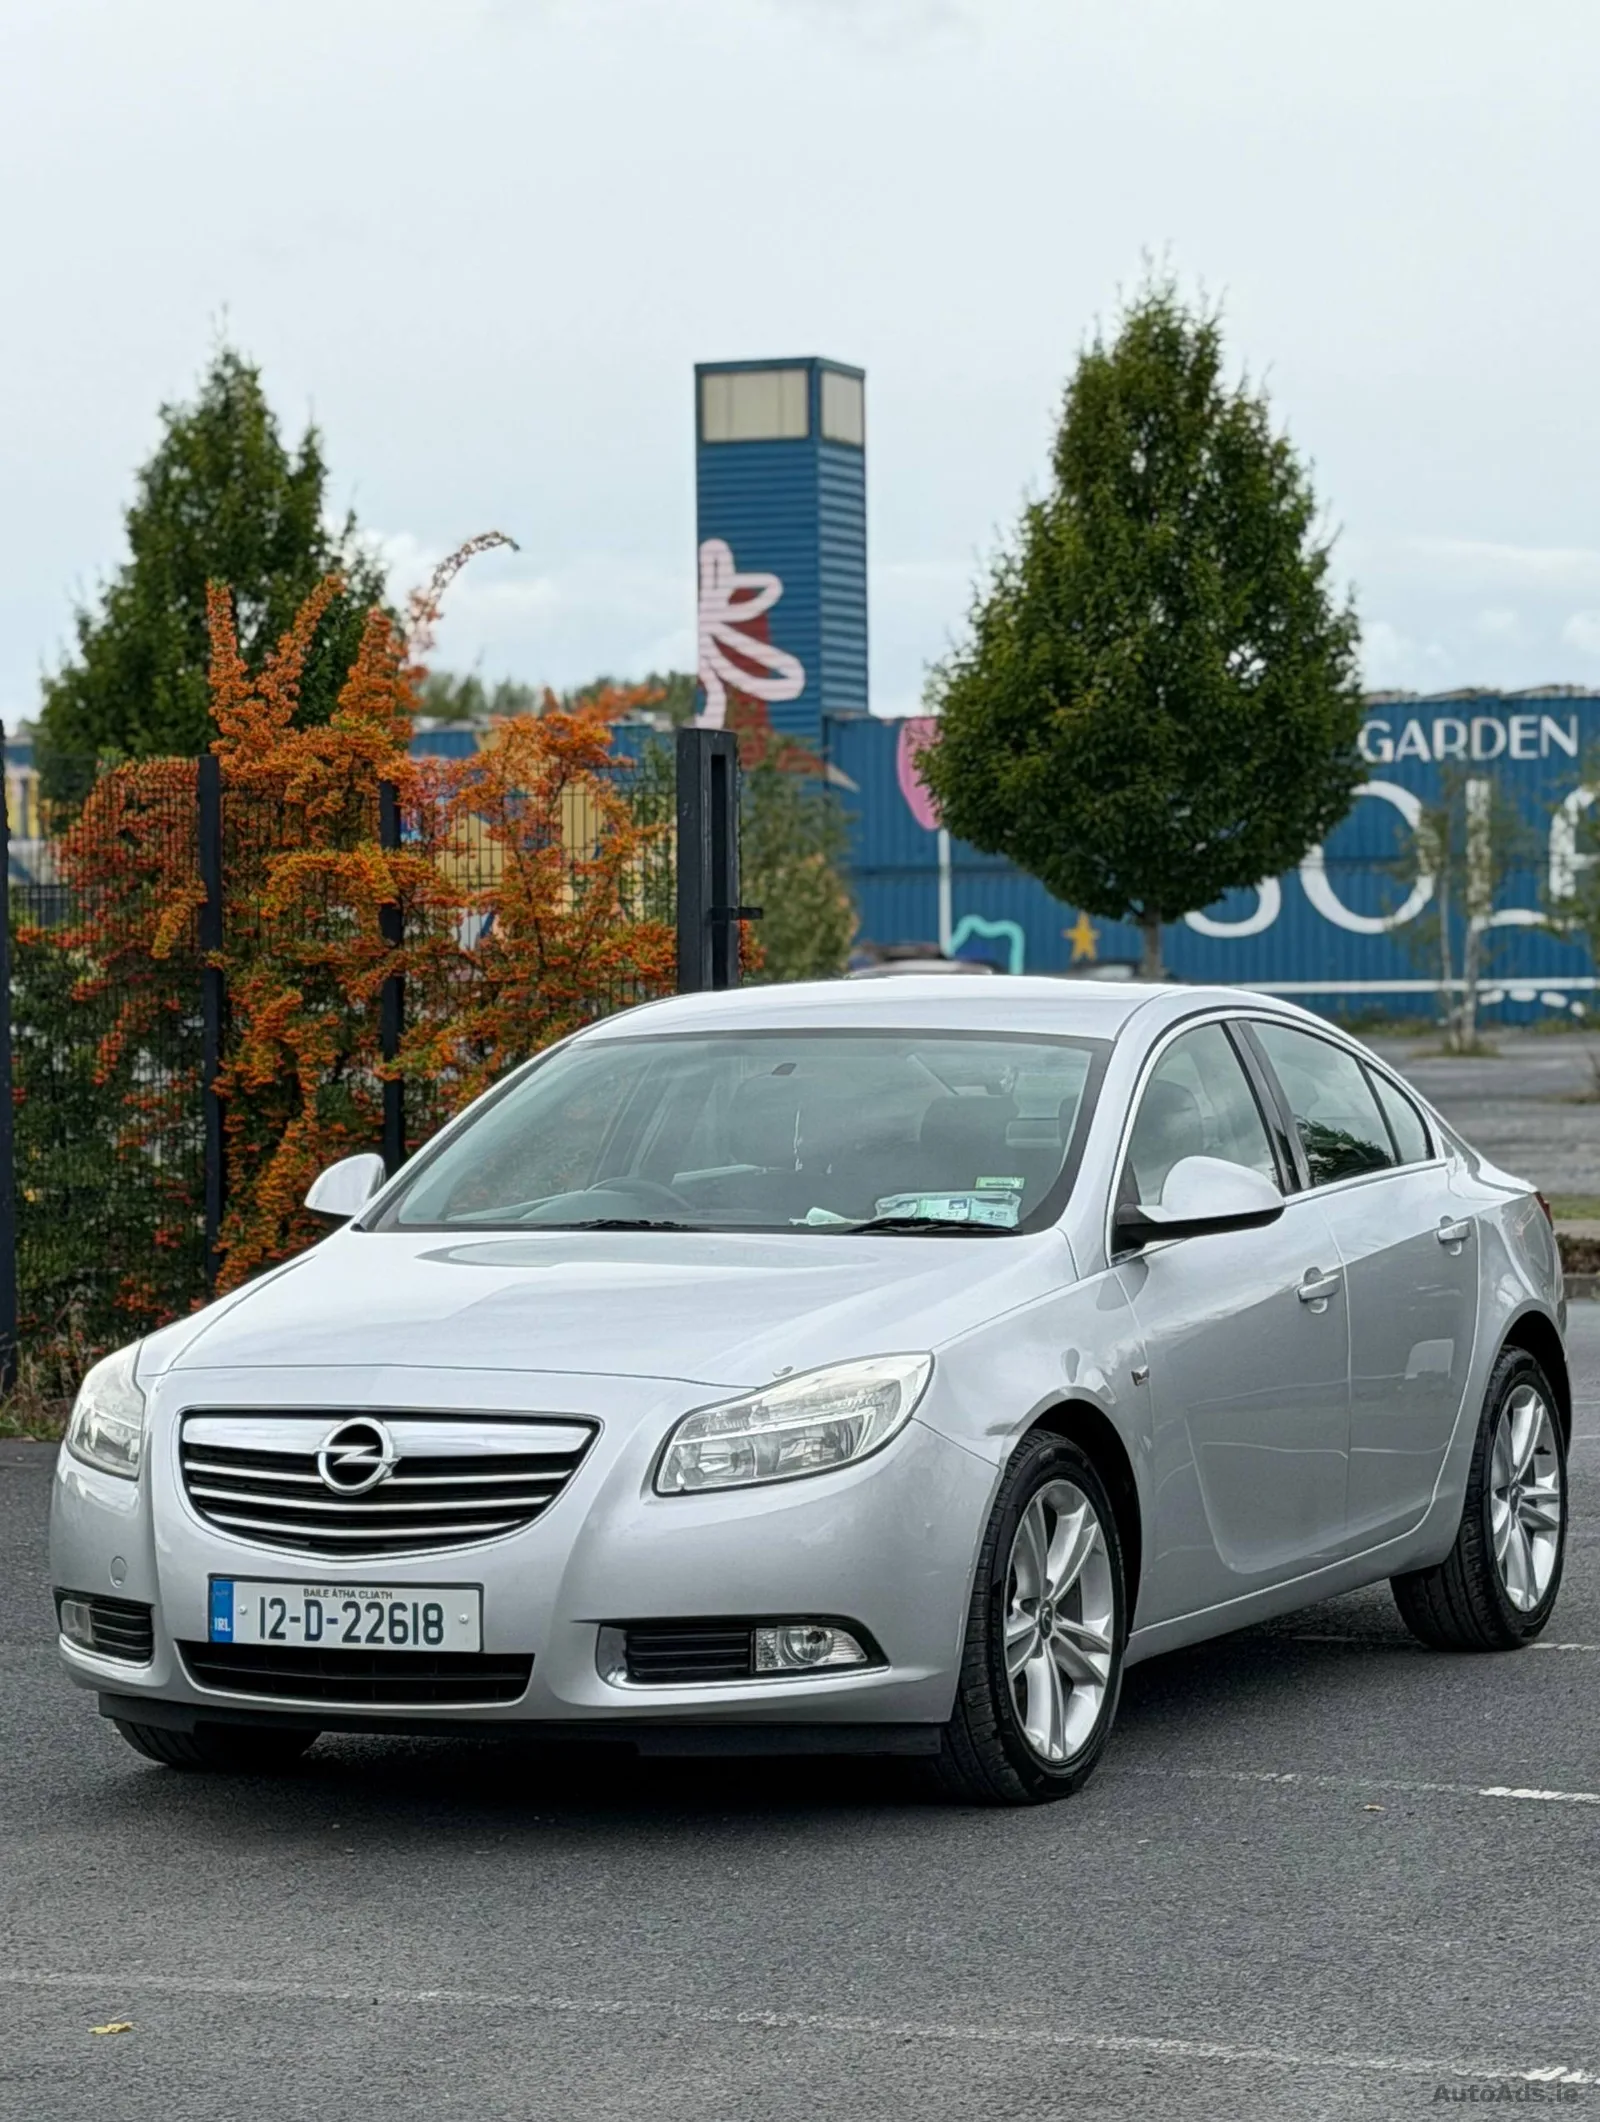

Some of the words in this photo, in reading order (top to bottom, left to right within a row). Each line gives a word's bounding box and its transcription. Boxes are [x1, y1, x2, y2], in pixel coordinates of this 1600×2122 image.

[1357, 714, 1579, 763] GARDEN
[303, 1588, 329, 1598] BAILE
[332, 1588, 356, 1598] ÁTHA
[358, 1590, 393, 1600] CLIATH
[214, 1617, 231, 1632] IRL
[259, 1596, 444, 1646] 12-D-22618
